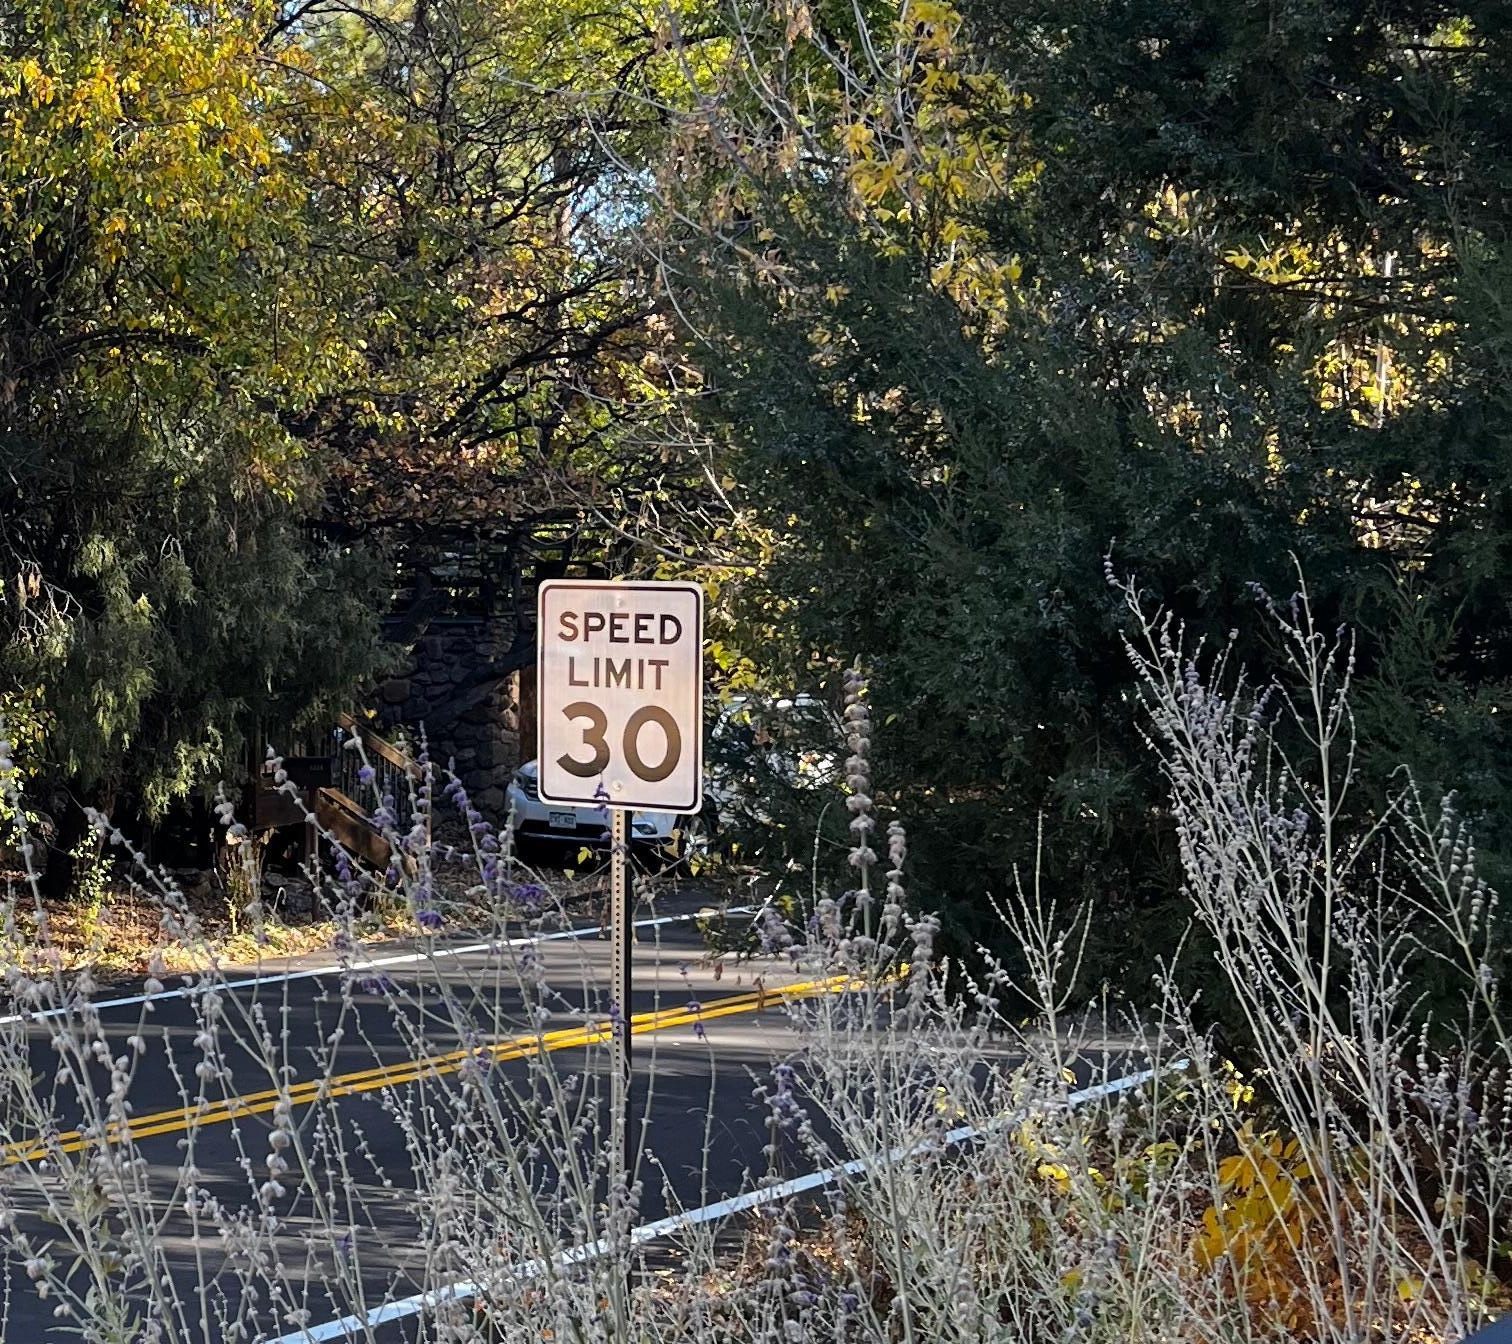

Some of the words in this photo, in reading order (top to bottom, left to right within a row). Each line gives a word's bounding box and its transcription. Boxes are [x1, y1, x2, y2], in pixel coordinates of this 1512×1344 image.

[558, 611, 682, 645] SPEED
[568, 656, 669, 690] LIMIT
[556, 701, 682, 783] 30
